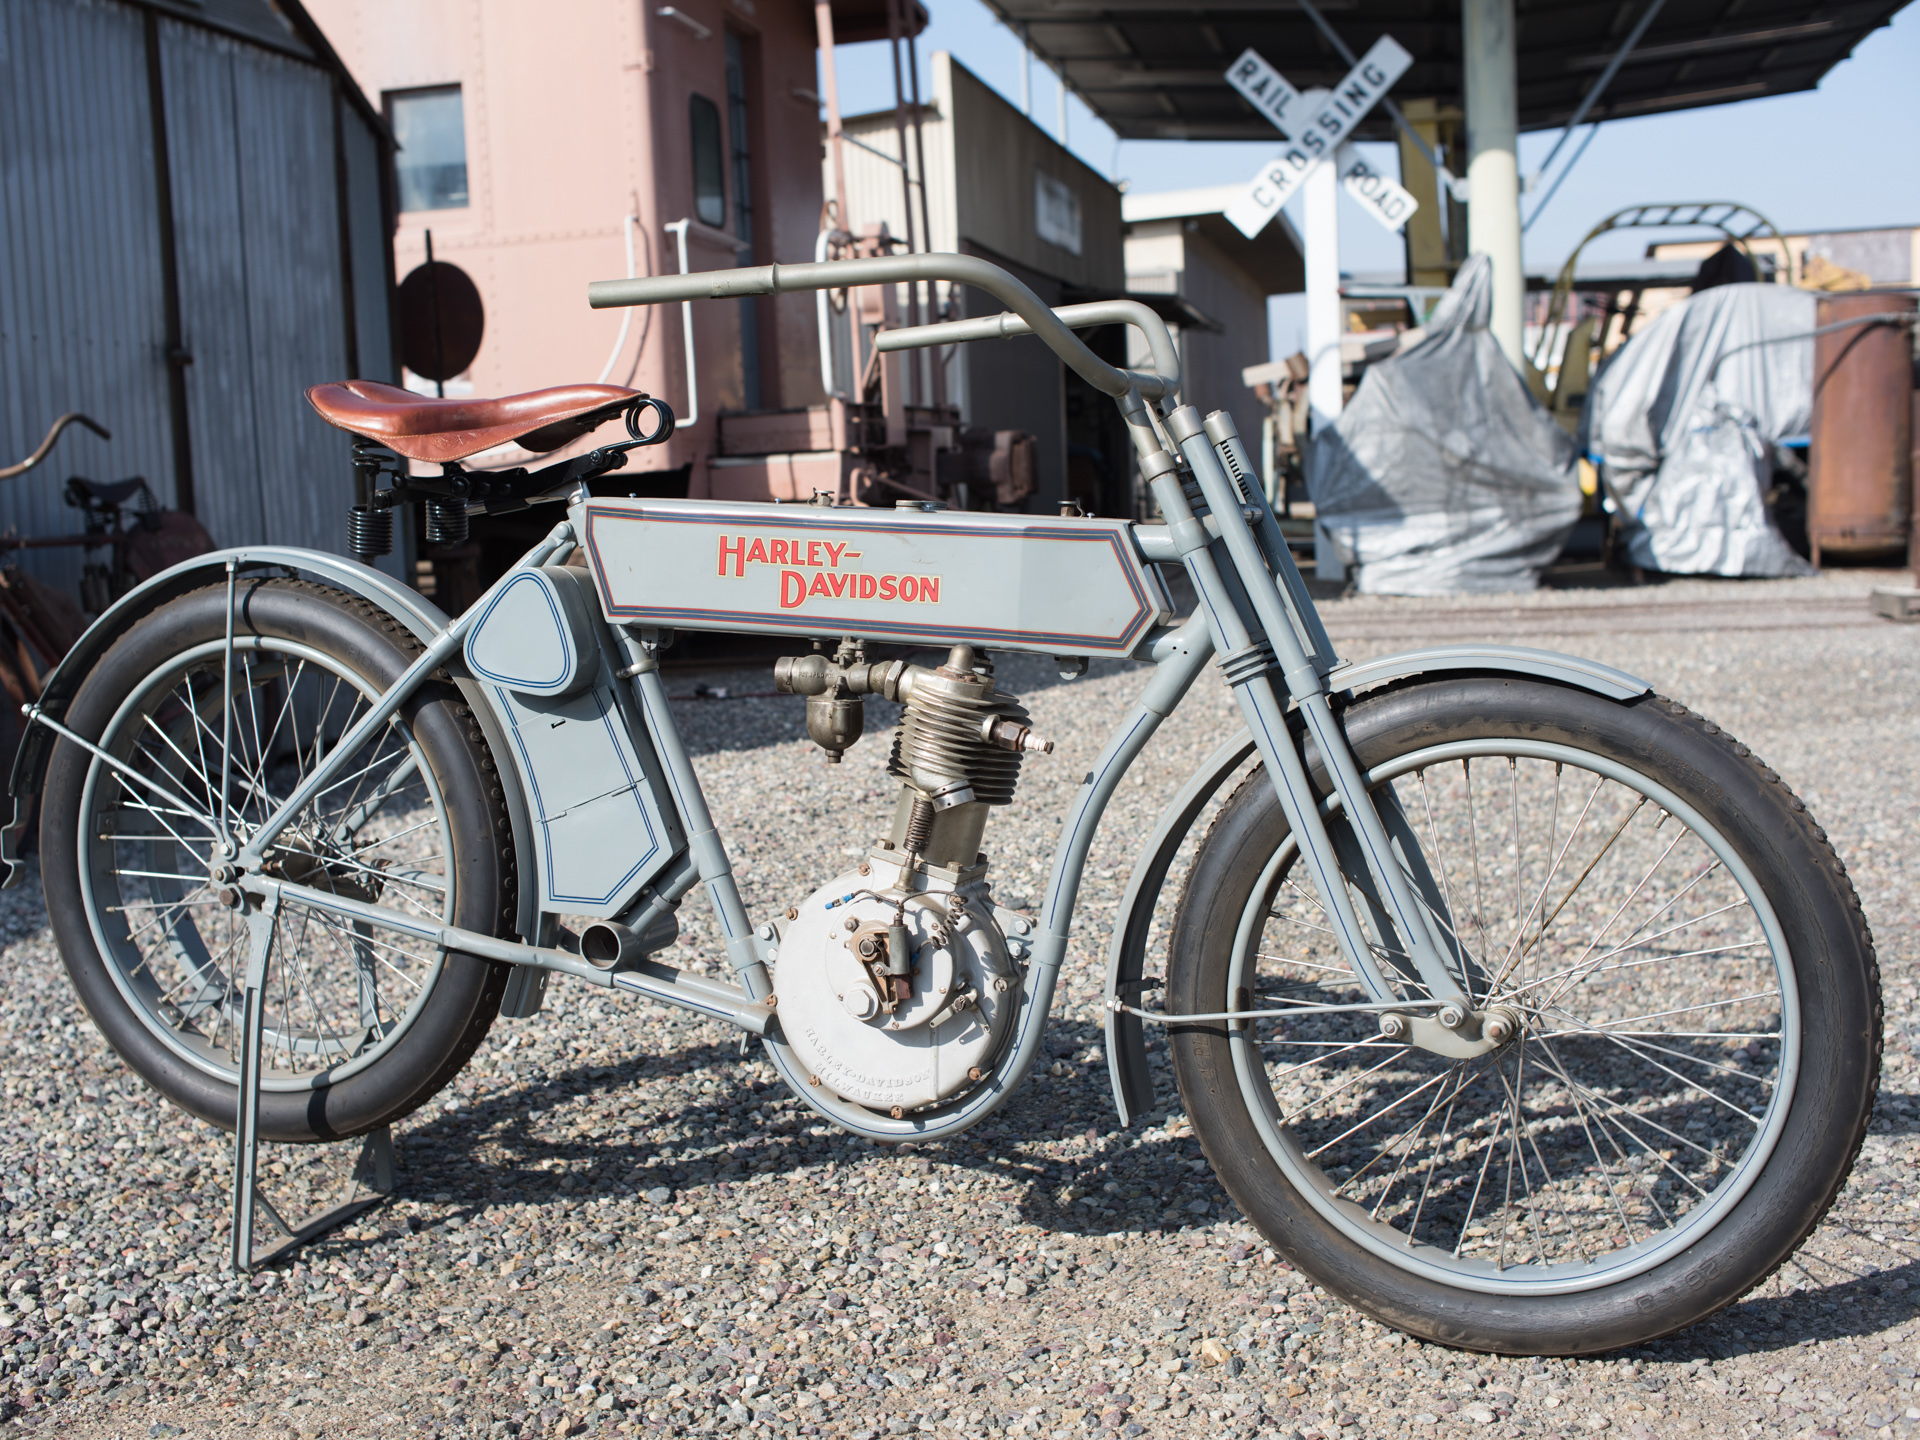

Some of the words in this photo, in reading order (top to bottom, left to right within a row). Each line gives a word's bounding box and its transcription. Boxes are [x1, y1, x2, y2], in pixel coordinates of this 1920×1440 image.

[1234, 57, 1292, 119] RAIL
[1346, 160, 1406, 220] ROAD
[1251, 61, 1387, 209] CROSSING
[717, 534, 863, 578] HARLEY-
[779, 568, 941, 609] DAVIDSON
[804, 1024, 931, 1088] HARLEY-DAVIDSON
[815, 1060, 905, 1102] MILWAUKEE
